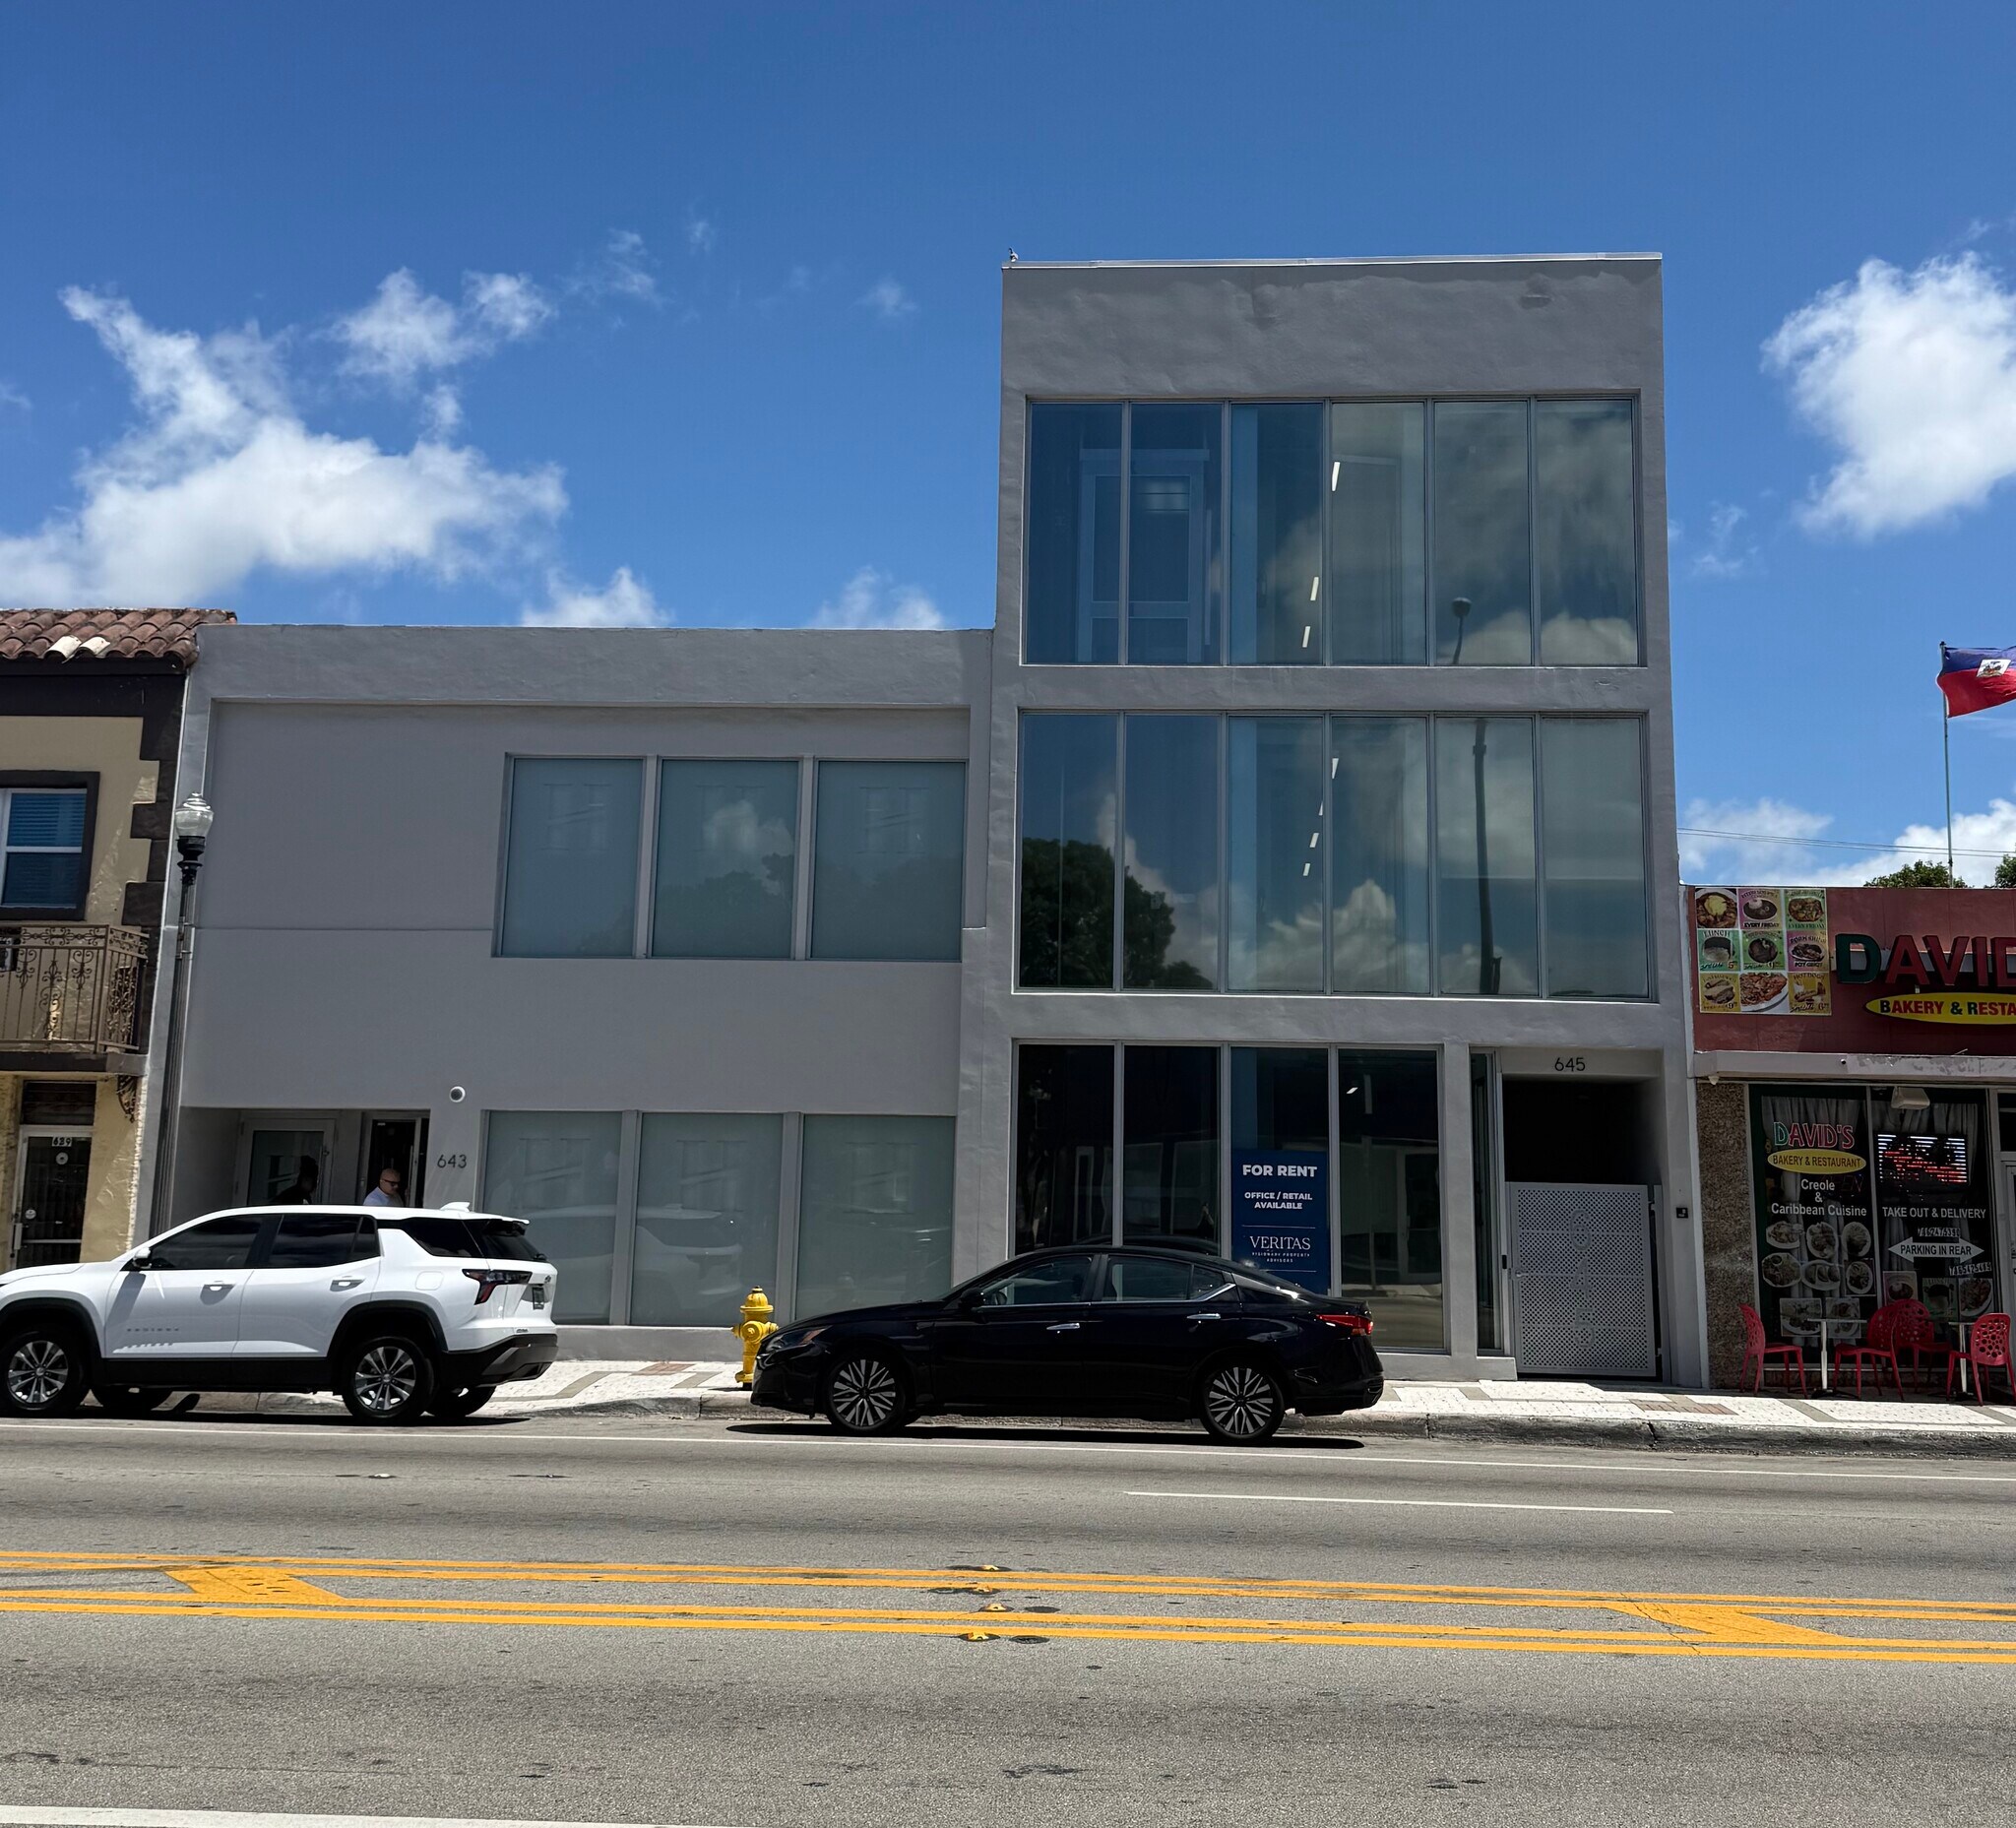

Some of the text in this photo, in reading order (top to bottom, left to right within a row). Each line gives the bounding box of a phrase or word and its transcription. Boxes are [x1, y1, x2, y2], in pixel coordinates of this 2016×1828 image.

[1880, 1000, 1944, 1015] BAKERY
[1951, 1001, 1963, 1015] &
[1554, 1057, 1586, 1072] 645
[1773, 1121, 1856, 1150] DAVID'S
[437, 1154, 467, 1168] 643
[1773, 1155, 1861, 1167] BAKERY & RESTAURANT
[1242, 1165, 1318, 1177] FOR RENT
[1800, 1178, 1836, 1191] Creole
[1283, 1192, 1313, 1201] RETAIL
[1814, 1191, 1823, 1203] &
[1254, 1201, 1303, 1210] AVAILABLE
[1771, 1202, 1867, 1217] Caribbean Cuisine
[1882, 1207, 1986, 1219] TAKE OUT & DELIVERY
[1249, 1235, 1311, 1250] VERITAS
[1900, 1244, 1972, 1256] PARKING IN REAR
